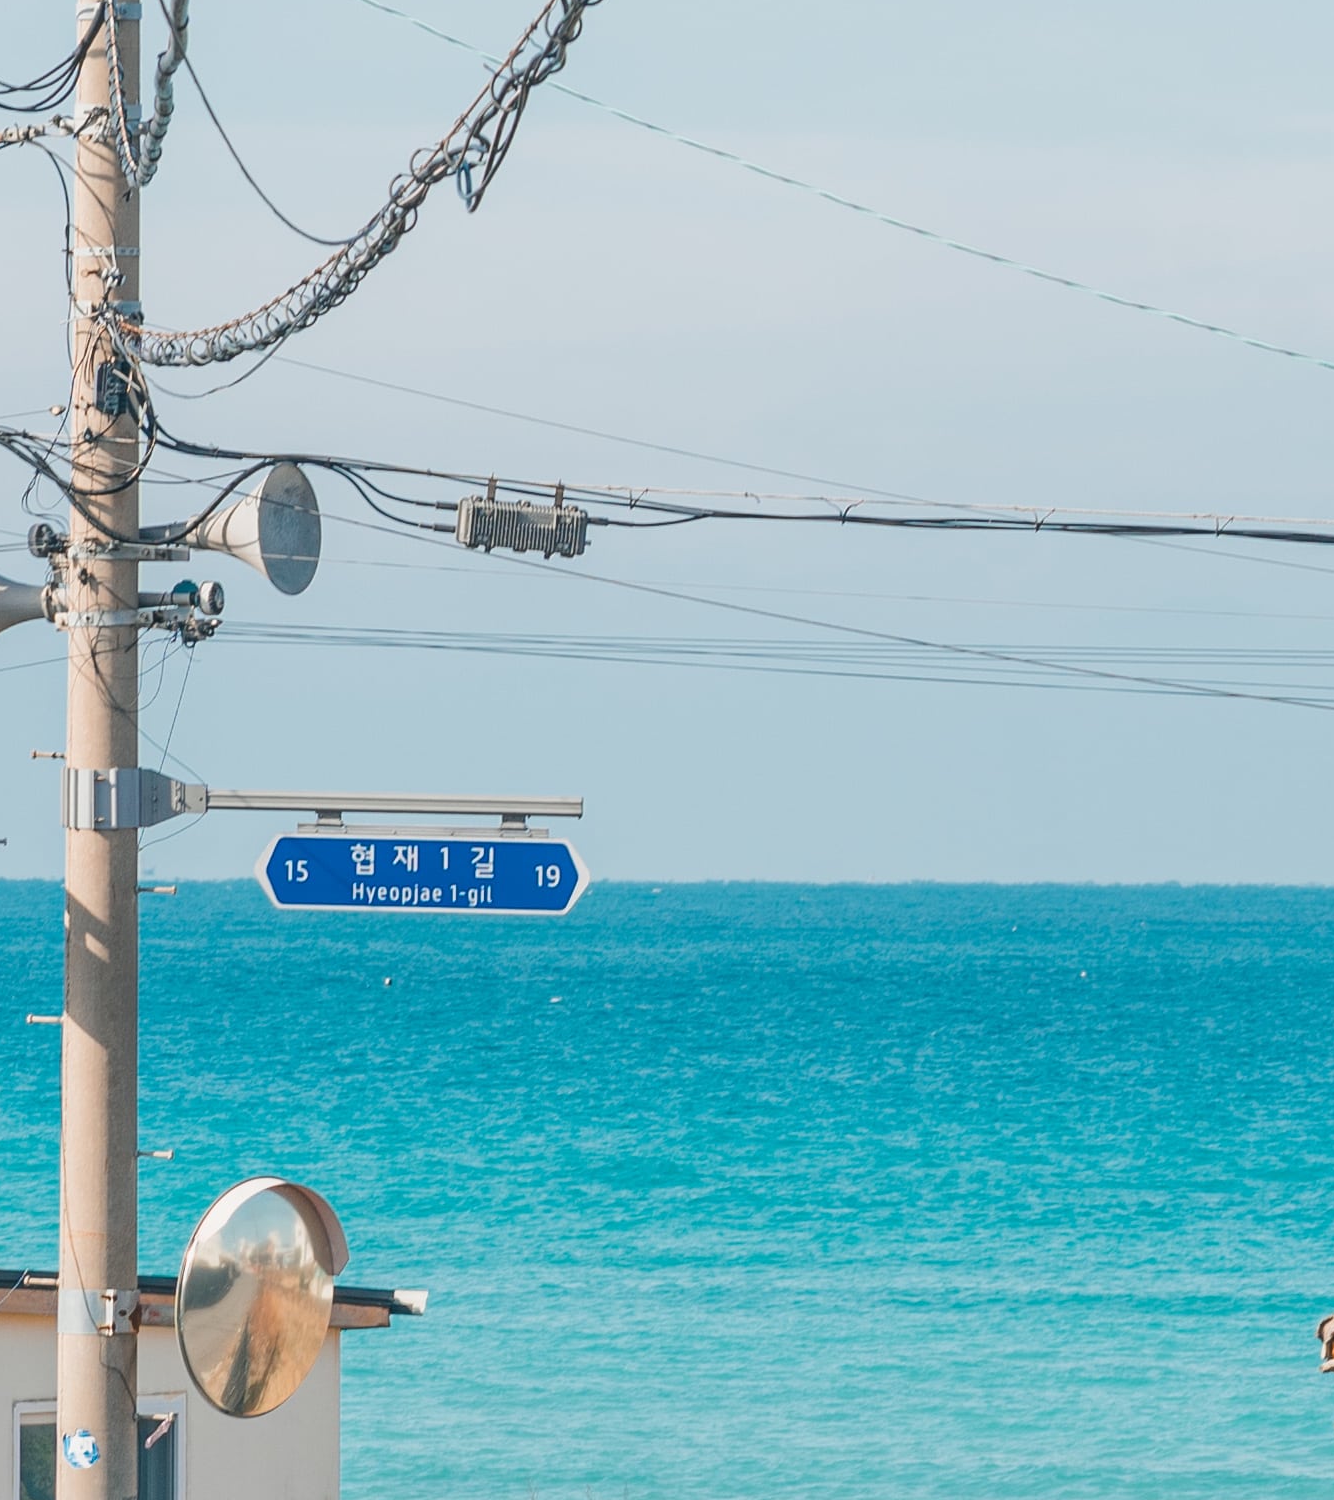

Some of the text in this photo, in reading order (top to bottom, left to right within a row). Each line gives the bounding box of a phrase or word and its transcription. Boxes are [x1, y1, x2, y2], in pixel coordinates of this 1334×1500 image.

[284, 859, 309, 883] 15
[534, 864, 561, 888] 19
[352, 882, 492, 908] Hyeopjae 1-gil
